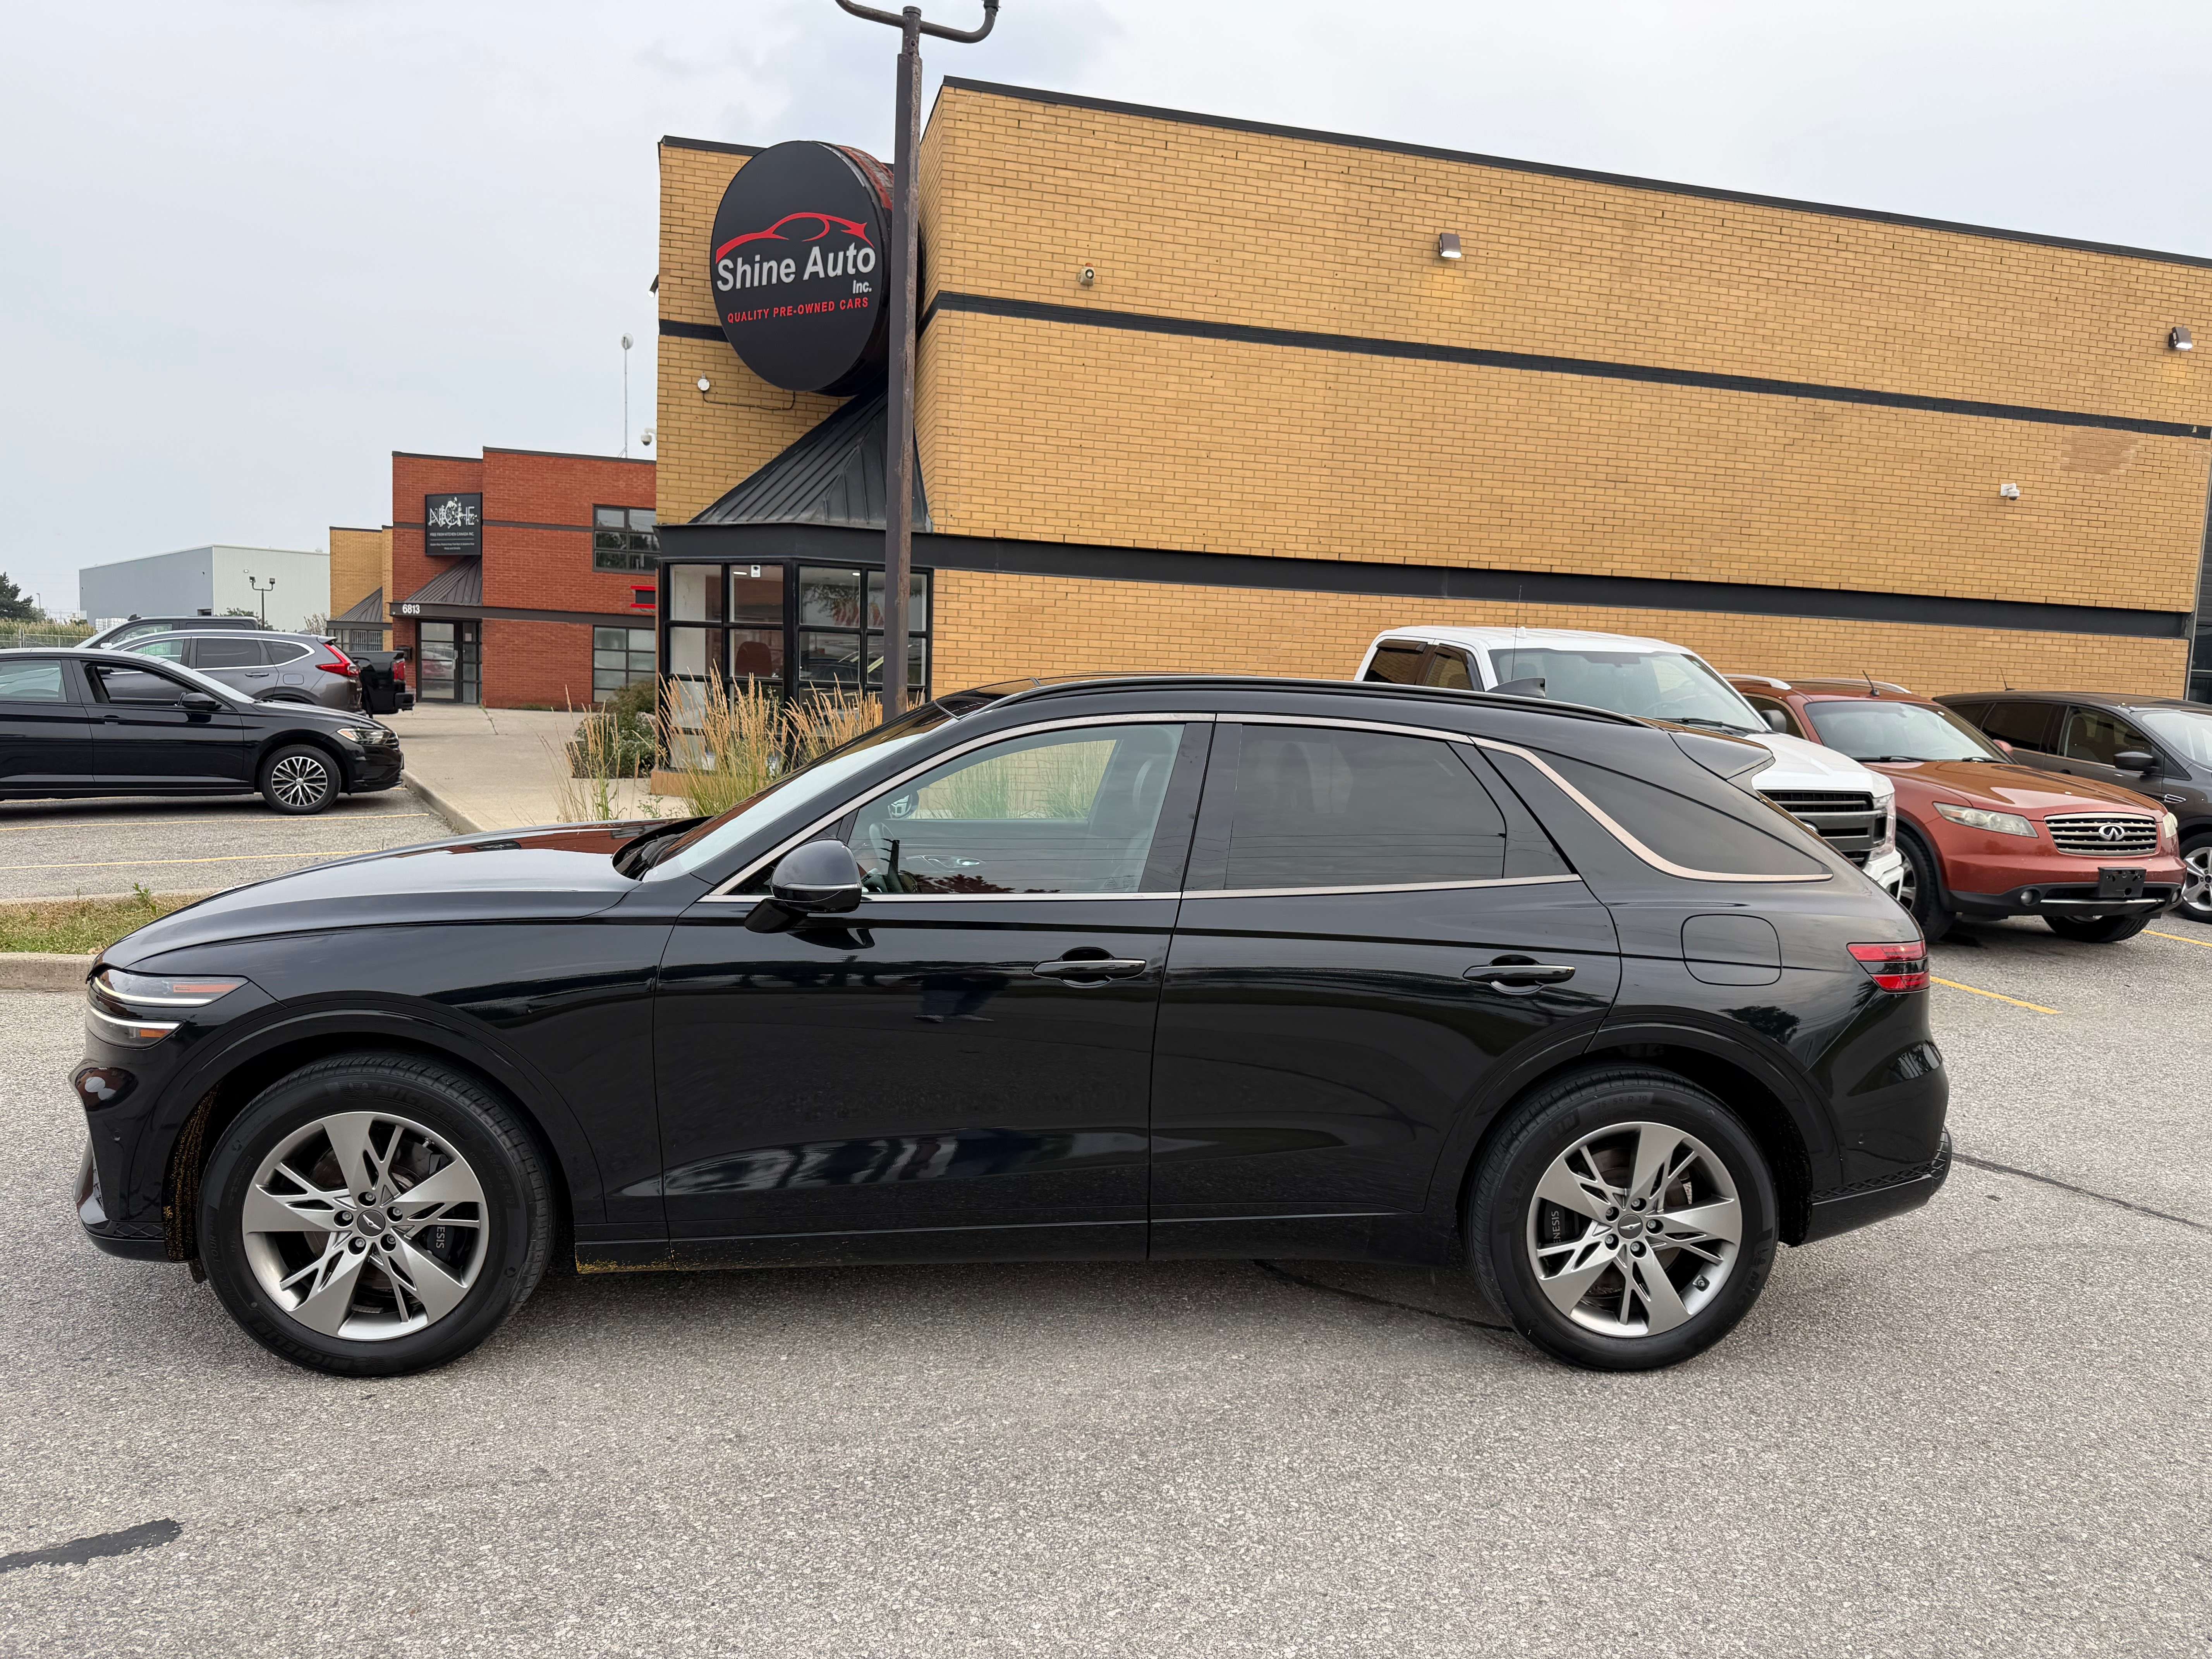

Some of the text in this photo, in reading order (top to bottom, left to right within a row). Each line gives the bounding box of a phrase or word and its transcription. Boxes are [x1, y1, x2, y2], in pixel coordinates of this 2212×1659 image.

[717, 242, 876, 292] Shine Auto
[852, 279, 872, 294] Inc.
[727, 297, 869, 324] QUALITY PRE-OWNED CARS
[402, 604, 420, 614] 6813
[209, 1234, 221, 1263] TOUR
[436, 1226, 445, 1249] ESIS
[252, 1321, 352, 1371] MICHELIN
